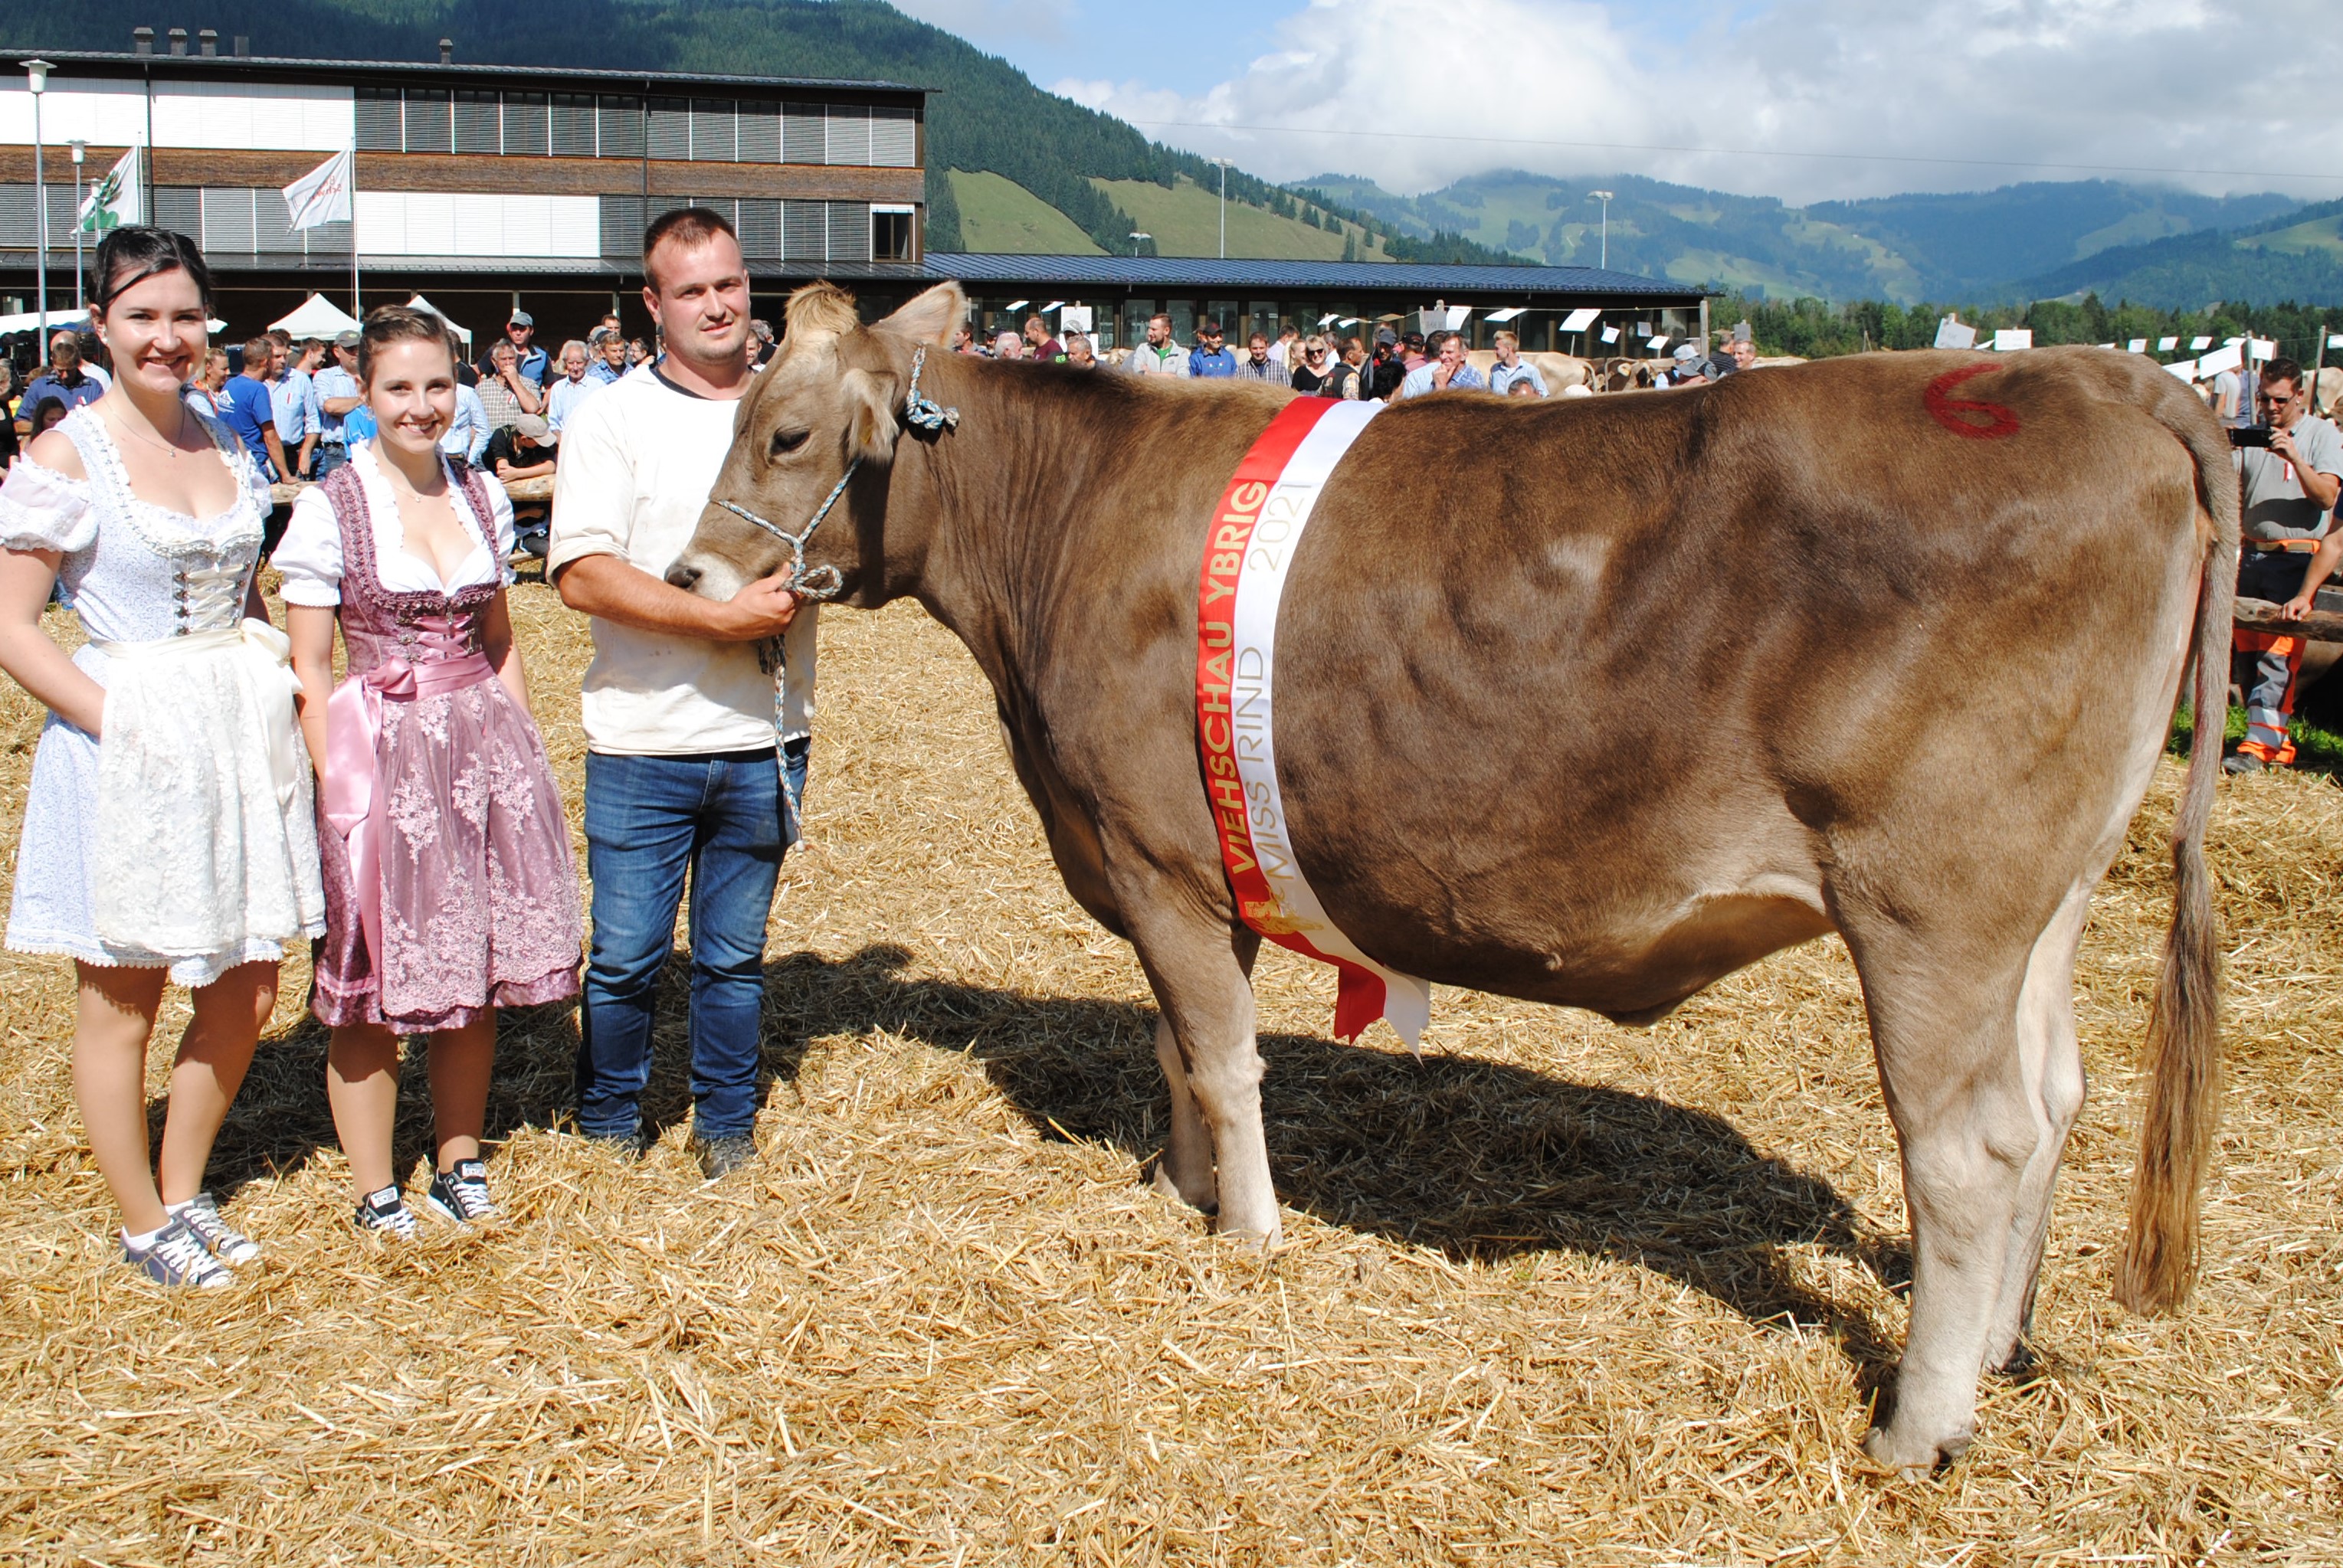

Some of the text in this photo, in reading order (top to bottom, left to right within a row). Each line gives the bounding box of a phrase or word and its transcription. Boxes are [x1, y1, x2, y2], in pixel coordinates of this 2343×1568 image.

[1923, 363, 2020, 441] 6
[1203, 481, 1267, 874] VIEHSCHAU YBRIG
[1236, 484, 1312, 879] MISS RIND 2021
